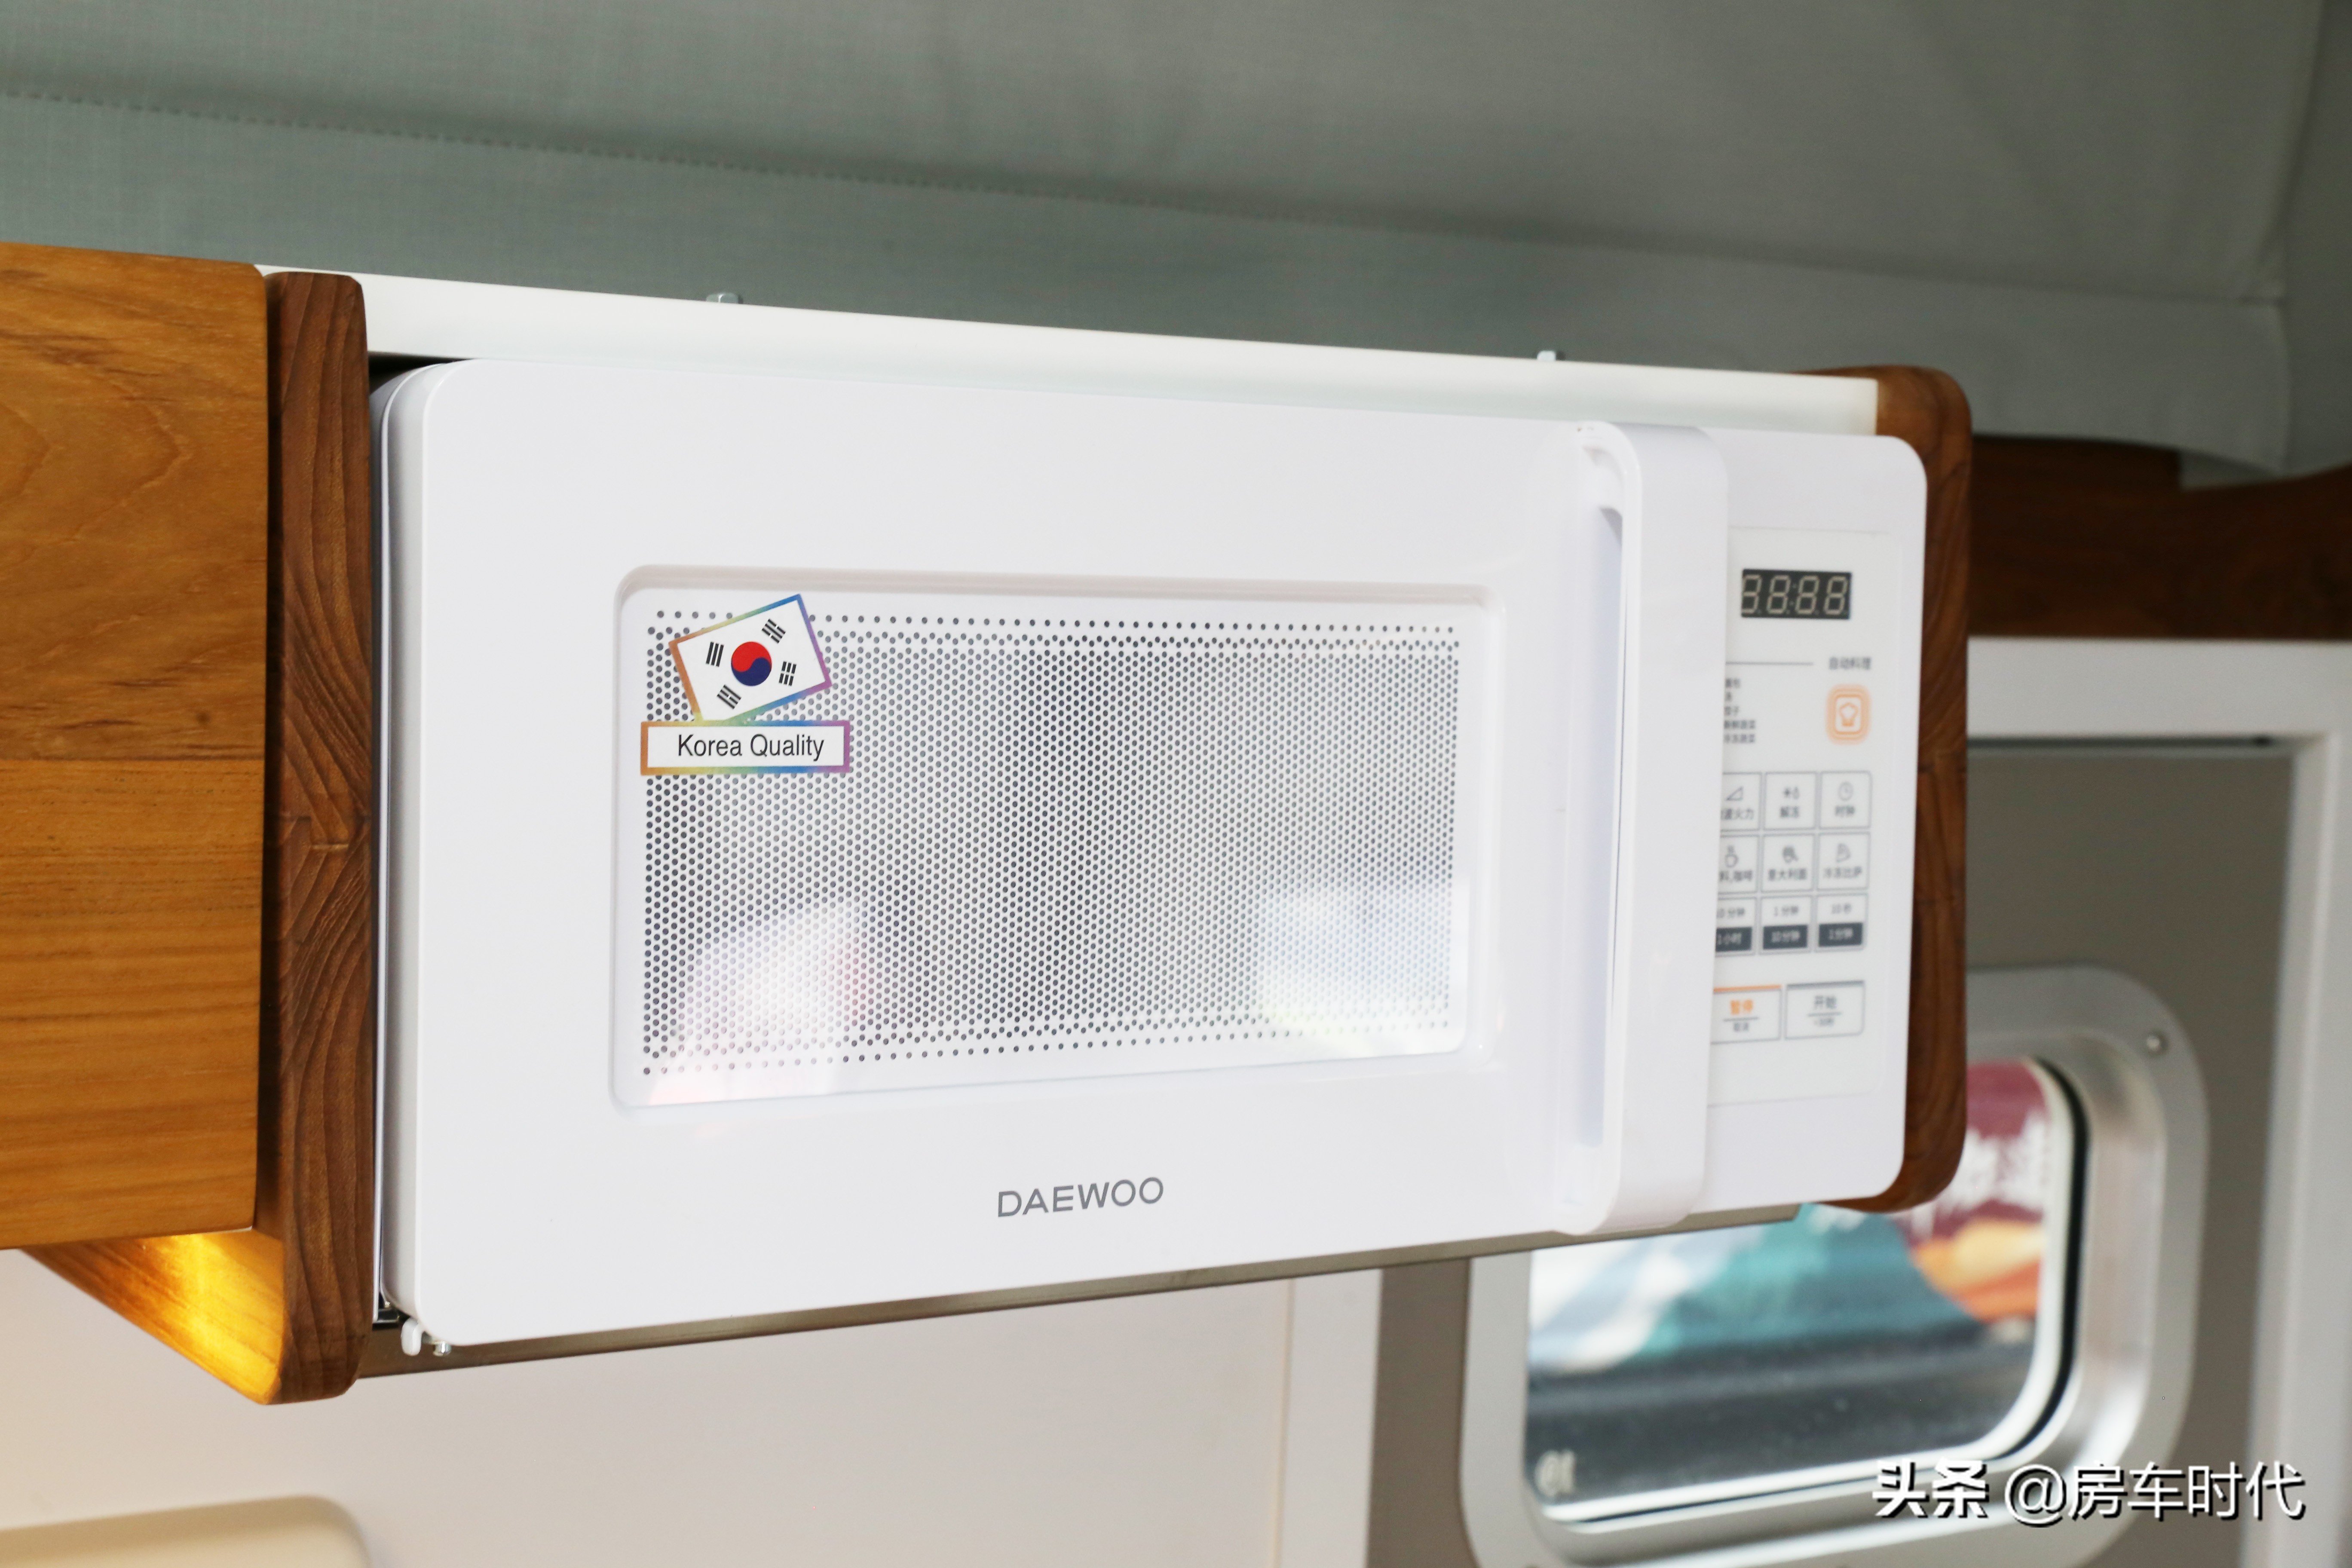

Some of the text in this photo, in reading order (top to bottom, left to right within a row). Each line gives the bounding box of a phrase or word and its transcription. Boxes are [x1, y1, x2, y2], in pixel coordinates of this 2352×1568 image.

[678, 734, 824, 762] Korea Quality
[1719, 808, 1754, 821] 波火力
[1730, 998, 1755, 1016] 暂停
[1813, 994, 1838, 1010] 开始
[998, 1176, 1164, 1217] DAEWOO
